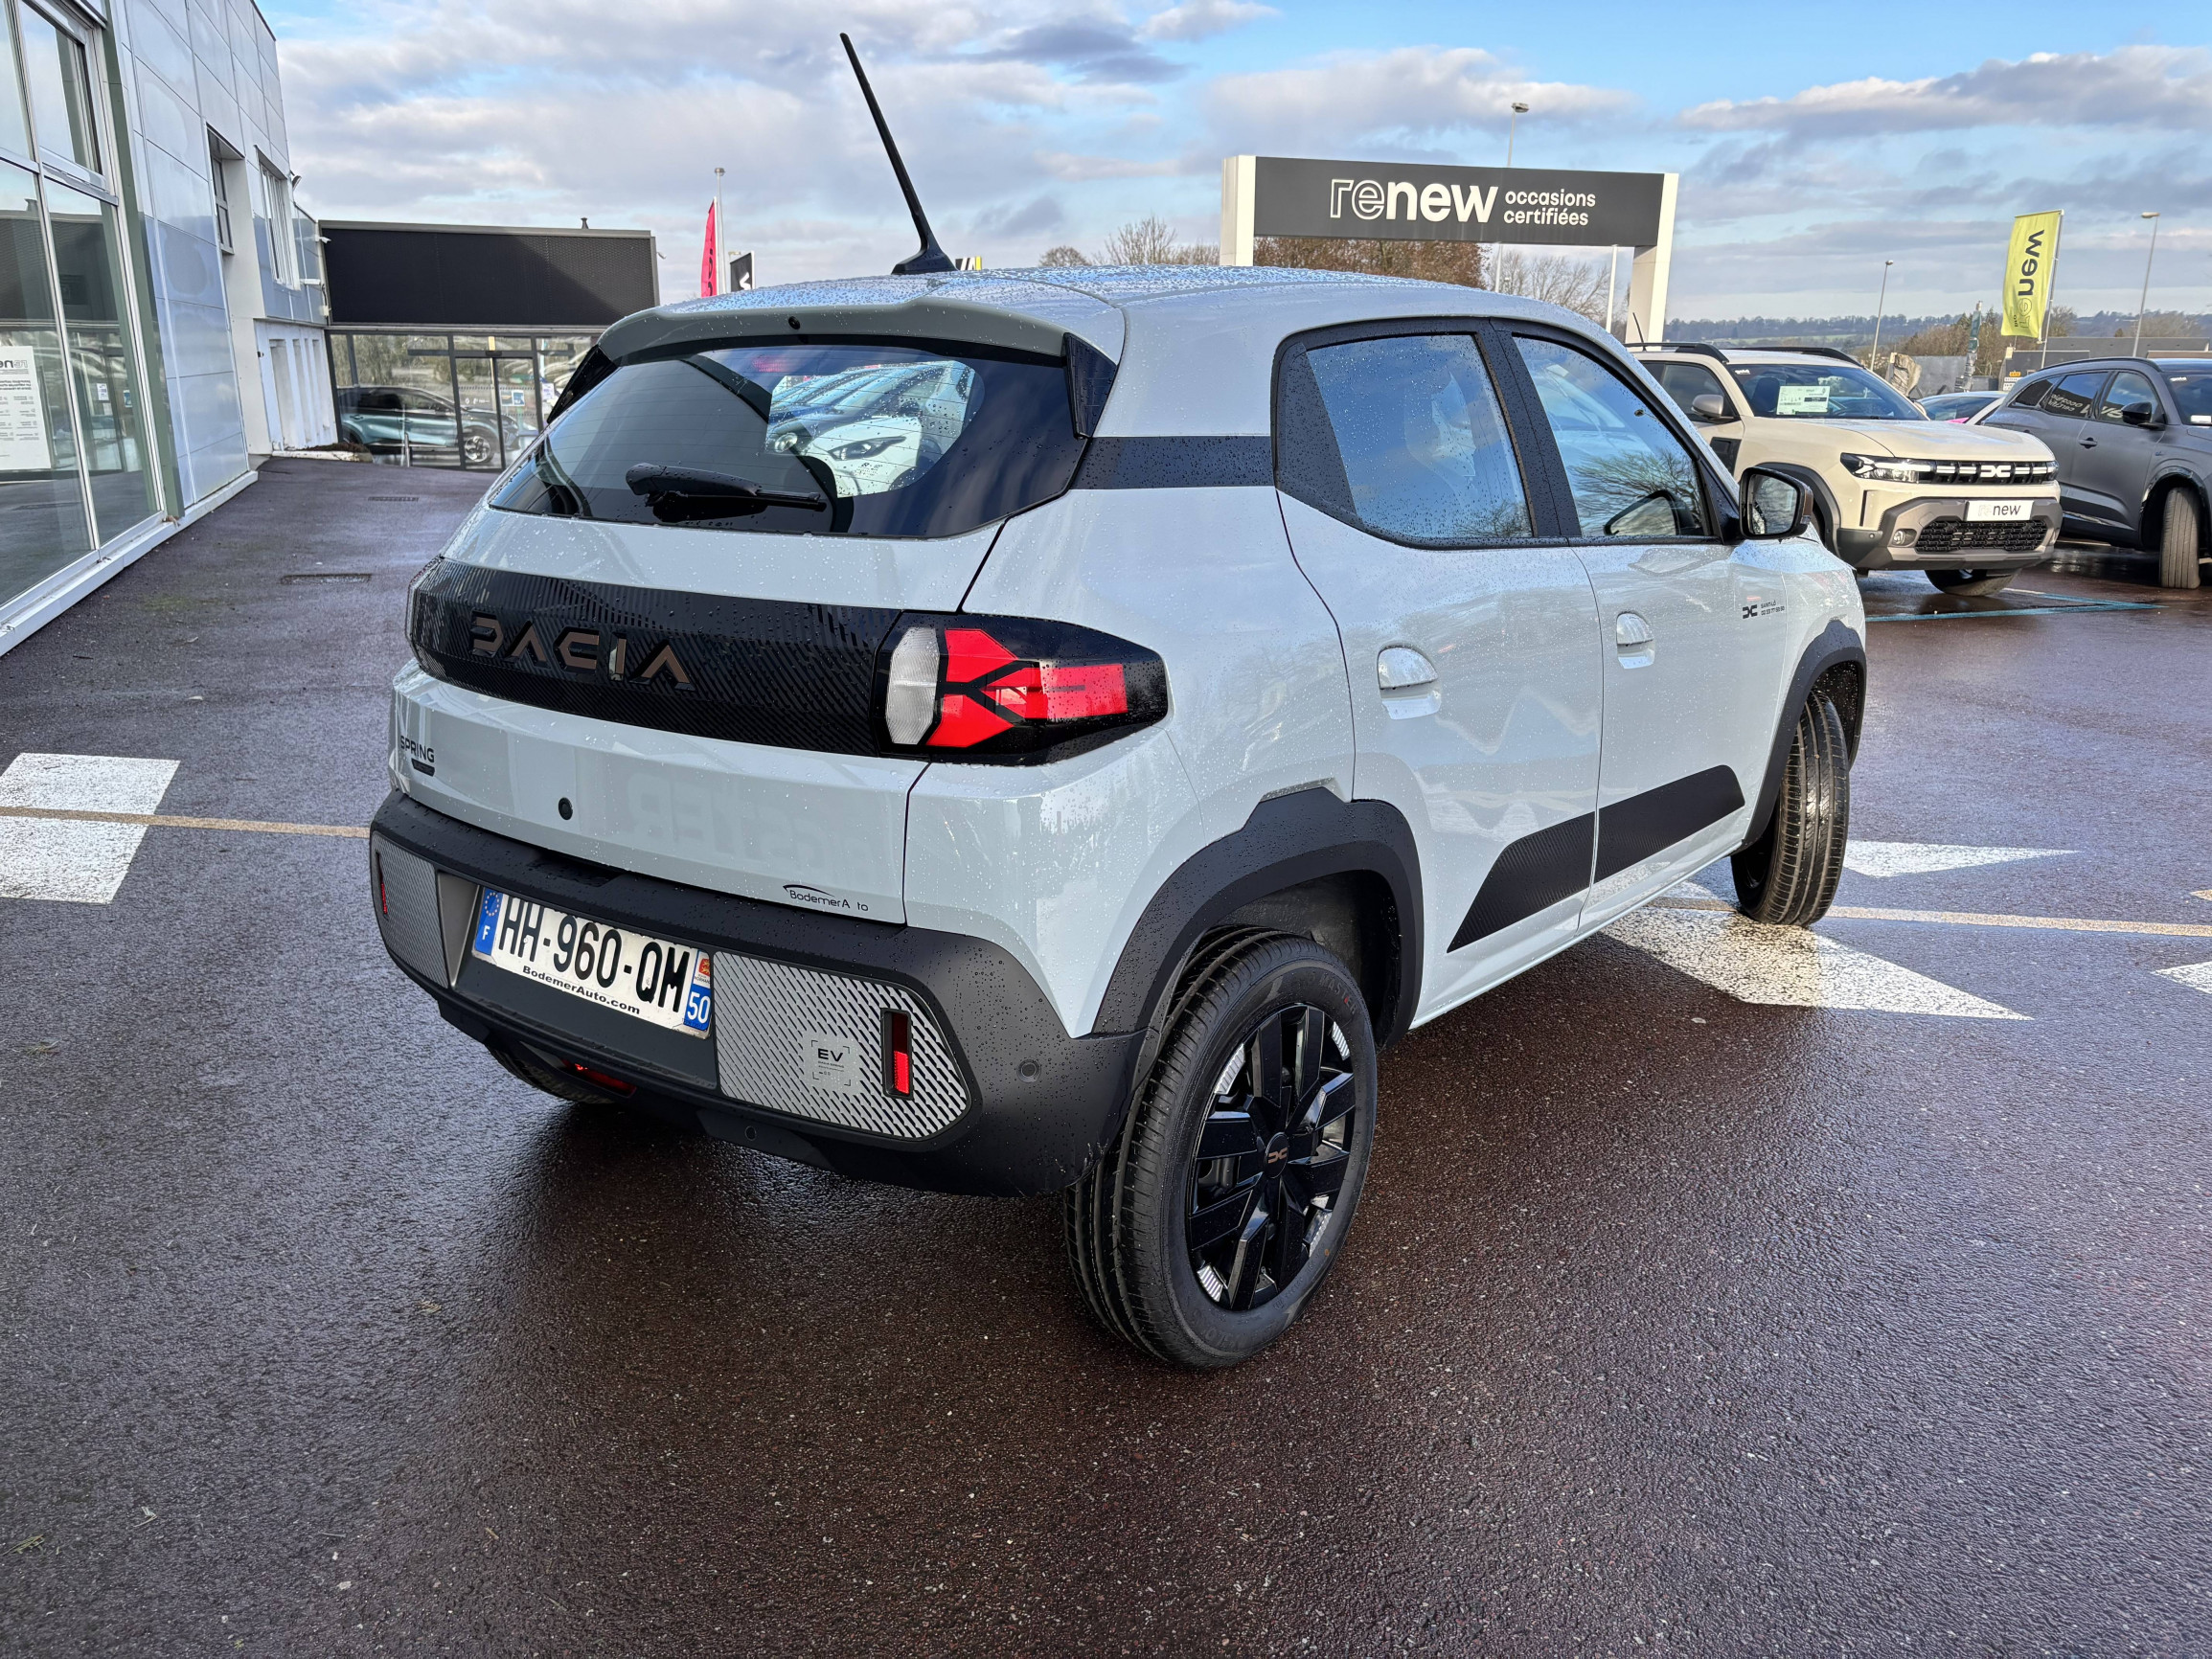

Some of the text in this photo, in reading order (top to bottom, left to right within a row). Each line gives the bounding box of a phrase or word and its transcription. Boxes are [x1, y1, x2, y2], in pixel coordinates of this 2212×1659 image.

[1330, 179, 1498, 223] renew
[1505, 189, 1596, 208] occasions
[1503, 208, 1589, 226] certifiées
[471, 611, 696, 690] DACIA
[400, 735, 435, 763] SPRING
[482, 925, 491, 942] F
[498, 895, 691, 1013] HH-960-QM
[522, 966, 640, 1015] BodemerAuto.com
[687, 990, 711, 1024] 50
[817, 1048, 843, 1062] EV
